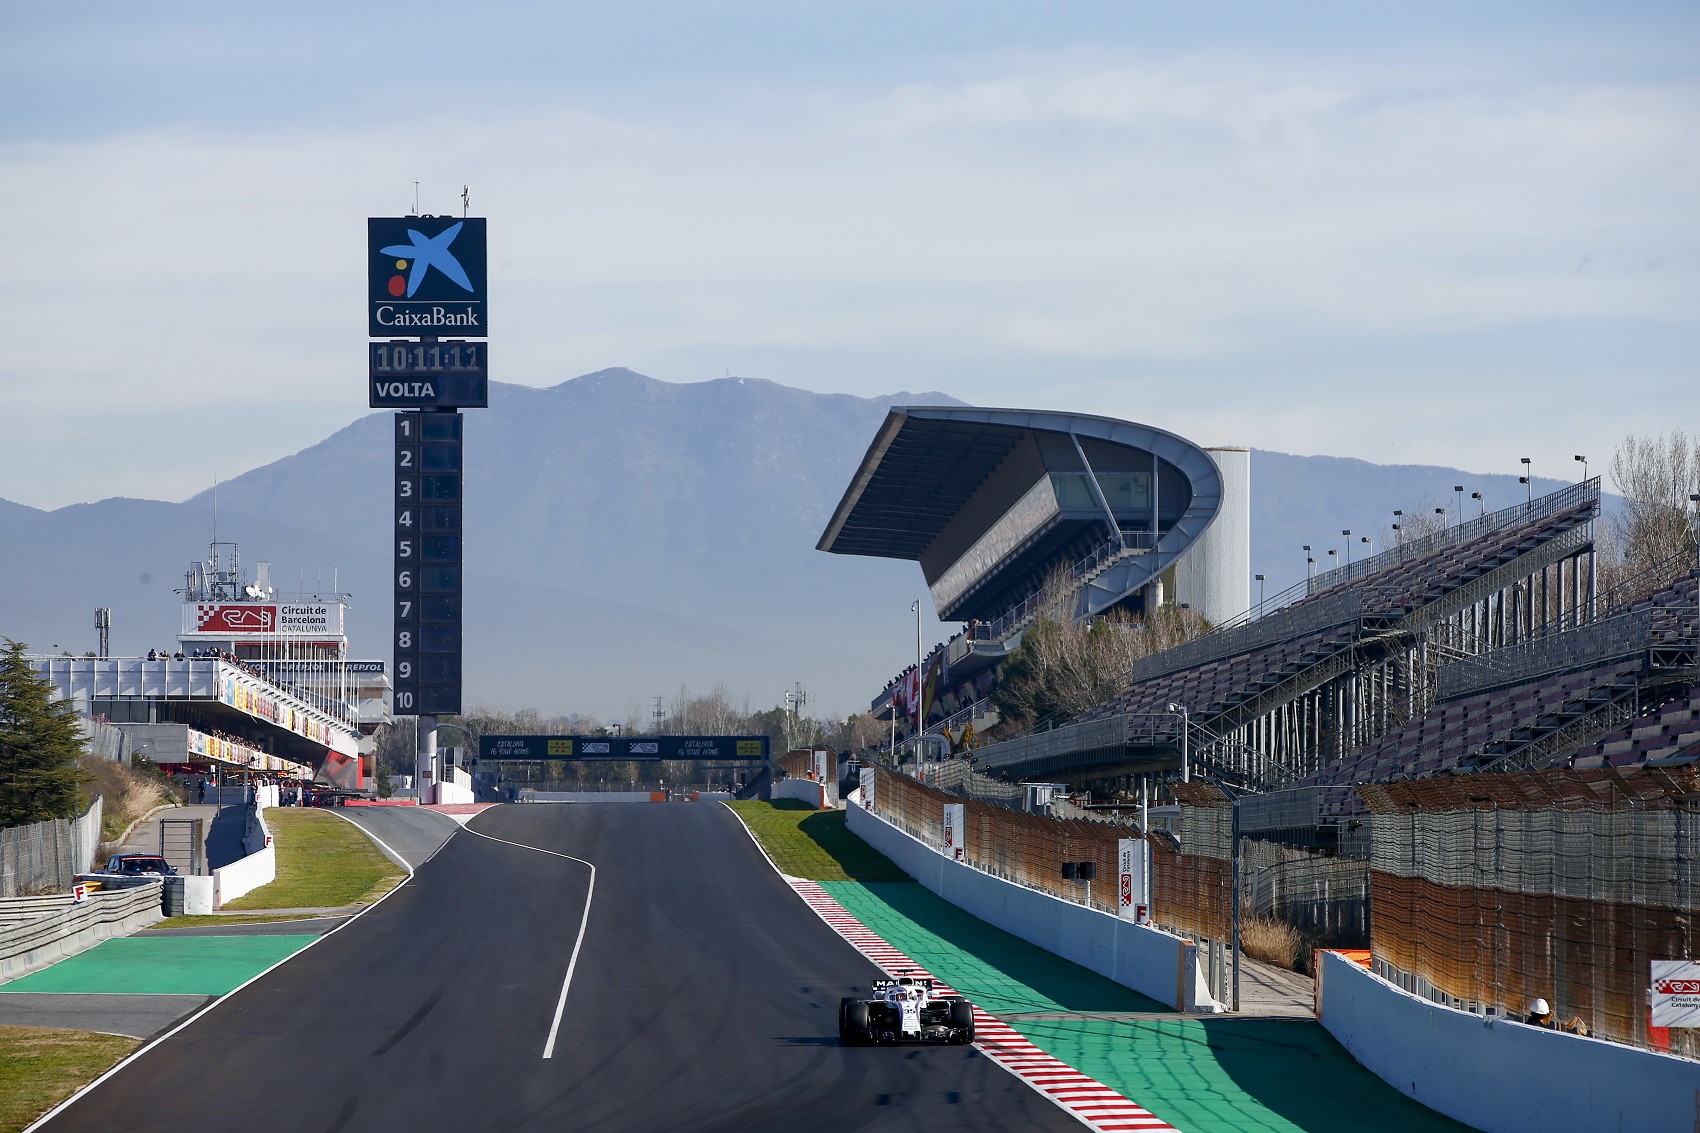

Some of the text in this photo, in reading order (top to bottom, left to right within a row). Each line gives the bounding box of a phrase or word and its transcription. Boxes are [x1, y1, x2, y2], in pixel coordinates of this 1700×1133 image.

[376, 306, 479, 326] CaixaBank
[376, 382, 435, 397] VOLTA
[400, 421, 410, 436] 1
[400, 451, 412, 466] 2
[400, 481, 412, 497] 3
[399, 511, 412, 527] 4
[400, 541, 411, 557] 5
[399, 571, 411, 587] 6
[281, 606, 327, 615] Circuit de
[399, 602, 411, 617] 7
[281, 616, 326, 624] Barcelona
[399, 632, 411, 647] 8
[346, 662, 382, 671] REPSOL
[399, 662, 412, 678] 9
[396, 692, 413, 708] 10
[866, 801, 871, 810] F
[266, 837, 272, 845] F
[956, 848, 963, 859] F
[75, 886, 84, 900] F
[1137, 906, 1147, 921] F
